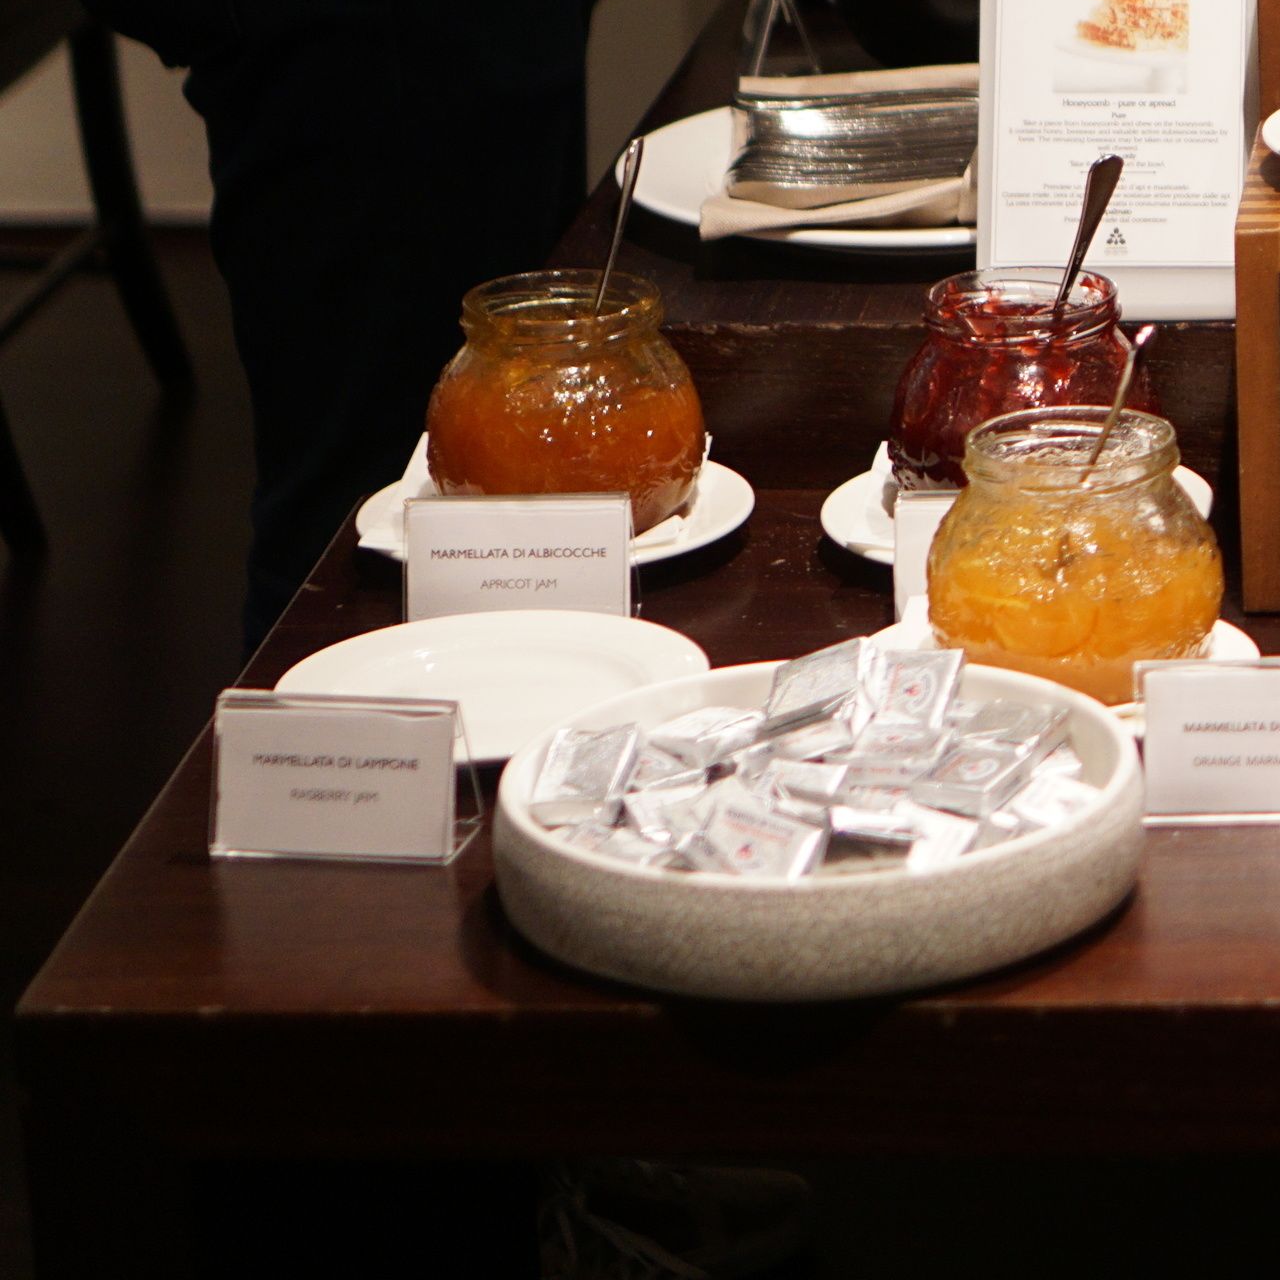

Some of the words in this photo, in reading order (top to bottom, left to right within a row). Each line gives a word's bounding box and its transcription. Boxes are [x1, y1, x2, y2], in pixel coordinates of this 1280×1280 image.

[1062, 99, 1110, 108] Honeycomb
[1118, 100, 1136, 108] pure
[430, 548, 509, 560] MARMELLATA
[512, 548, 526, 559] DI
[527, 547, 607, 559] ALBICOCCHE
[479, 578, 532, 590] APRICOT
[533, 578, 558, 592] JAM
[1182, 720, 1266, 733] MARMELLATA
[252, 753, 336, 768] MARMELLATA
[337, 755, 353, 769] DI
[354, 756, 420, 771] LAMPONE
[1192, 754, 1242, 768] ORANGE
[353, 791, 380, 805] JAM
